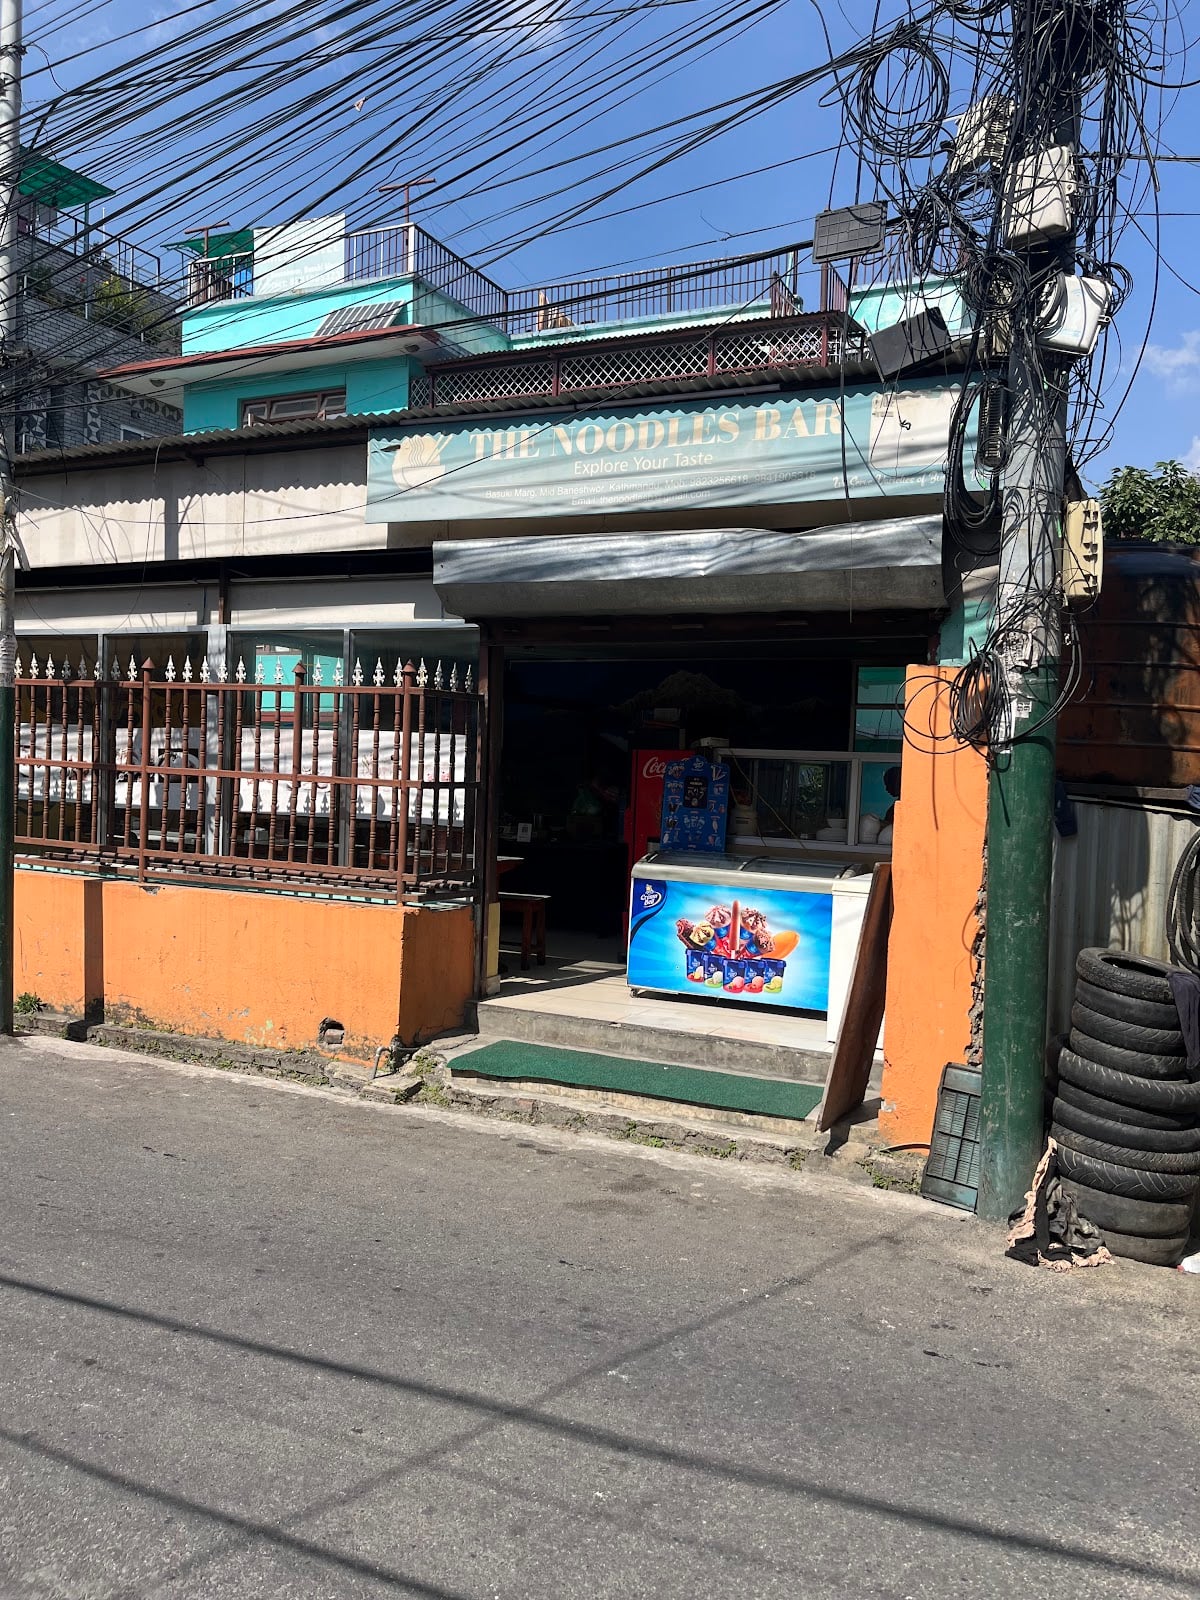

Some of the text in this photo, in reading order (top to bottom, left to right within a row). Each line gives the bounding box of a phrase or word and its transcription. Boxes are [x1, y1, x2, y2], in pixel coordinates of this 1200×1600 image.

[469, 402, 842, 461] THE NOODLES BAR
[574, 451, 713, 477] Explore Your Taste
[917, 473, 926, 487] of
[539, 486, 555, 497] Mid
